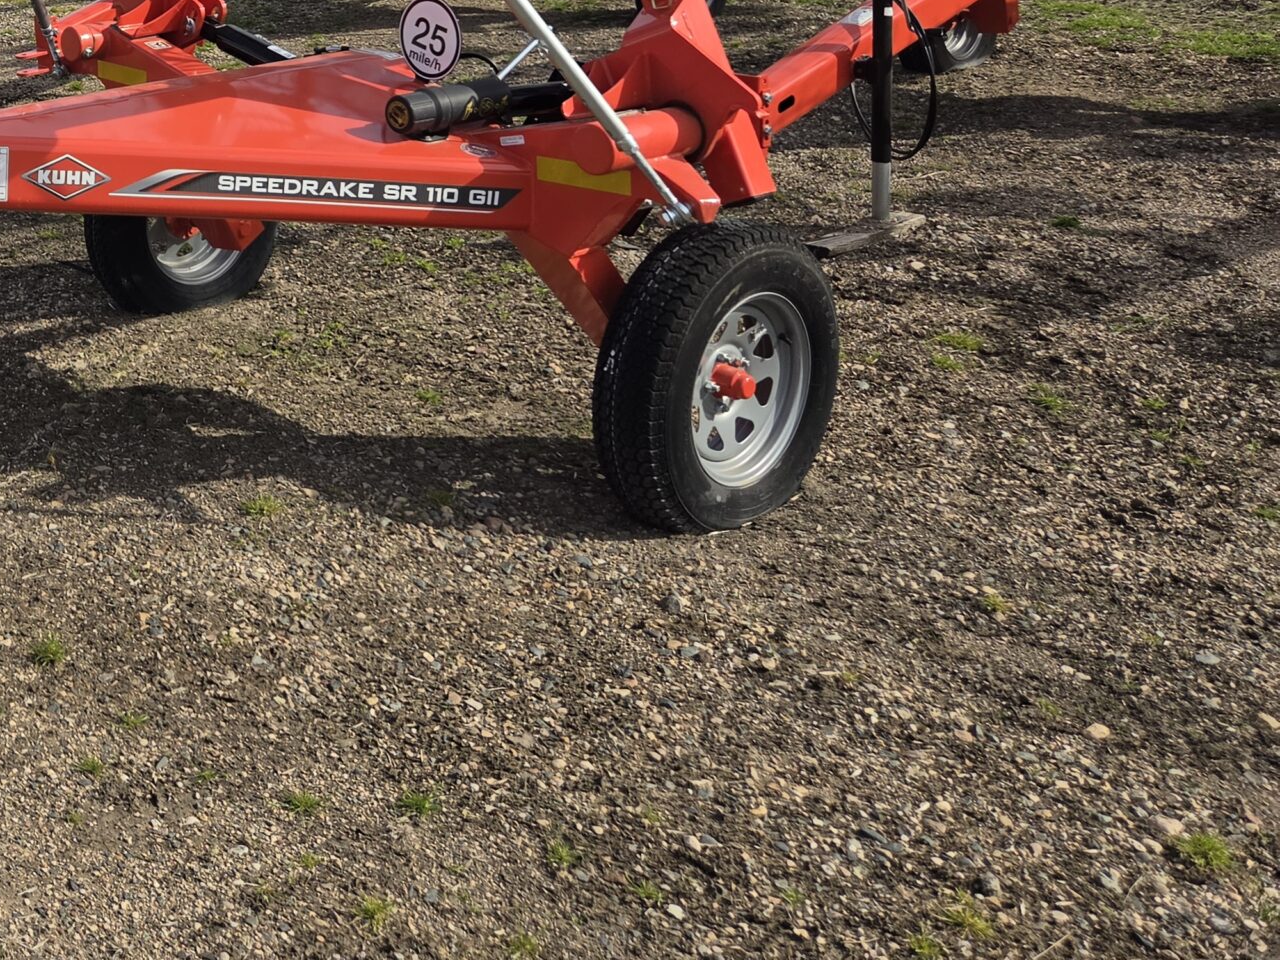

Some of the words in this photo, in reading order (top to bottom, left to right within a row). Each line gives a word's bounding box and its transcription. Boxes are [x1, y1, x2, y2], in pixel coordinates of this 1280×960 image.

[411, 16, 448, 57] 25
[408, 48, 442, 72] mile/h
[37, 169, 96, 186] KUHN
[217, 174, 374, 199] SPEEDRAKE
[383, 185, 418, 202] SR
[426, 187, 459, 204] 110
[468, 188, 500, 206] GII
